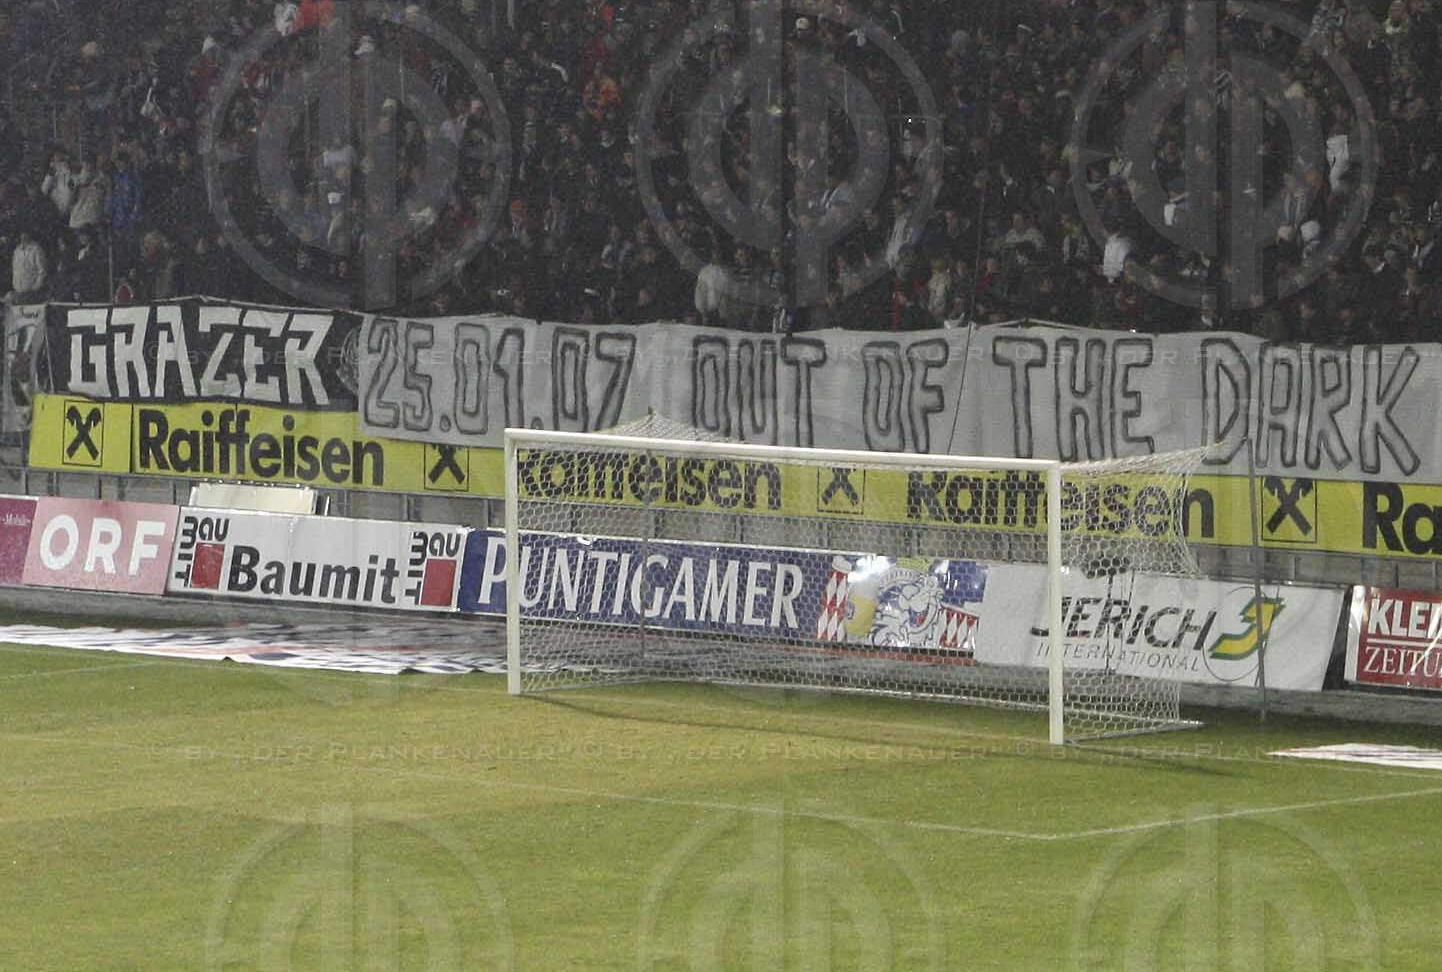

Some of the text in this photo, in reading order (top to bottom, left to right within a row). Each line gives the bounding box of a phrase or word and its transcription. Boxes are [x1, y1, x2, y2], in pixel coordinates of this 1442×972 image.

[67, 305, 334, 405] GRAZER
[363, 315, 637, 435] 25.01.07
[692, 334, 828, 448] OUT
[862, 337, 950, 454] OF
[991, 336, 1154, 462] THE
[1201, 337, 1421, 477] DARK
[139, 408, 385, 486] Raiffeisen
[40, 514, 166, 576] ORF
[226, 544, 400, 605] Baumit
[477, 535, 803, 629] PUNTIGAMER
